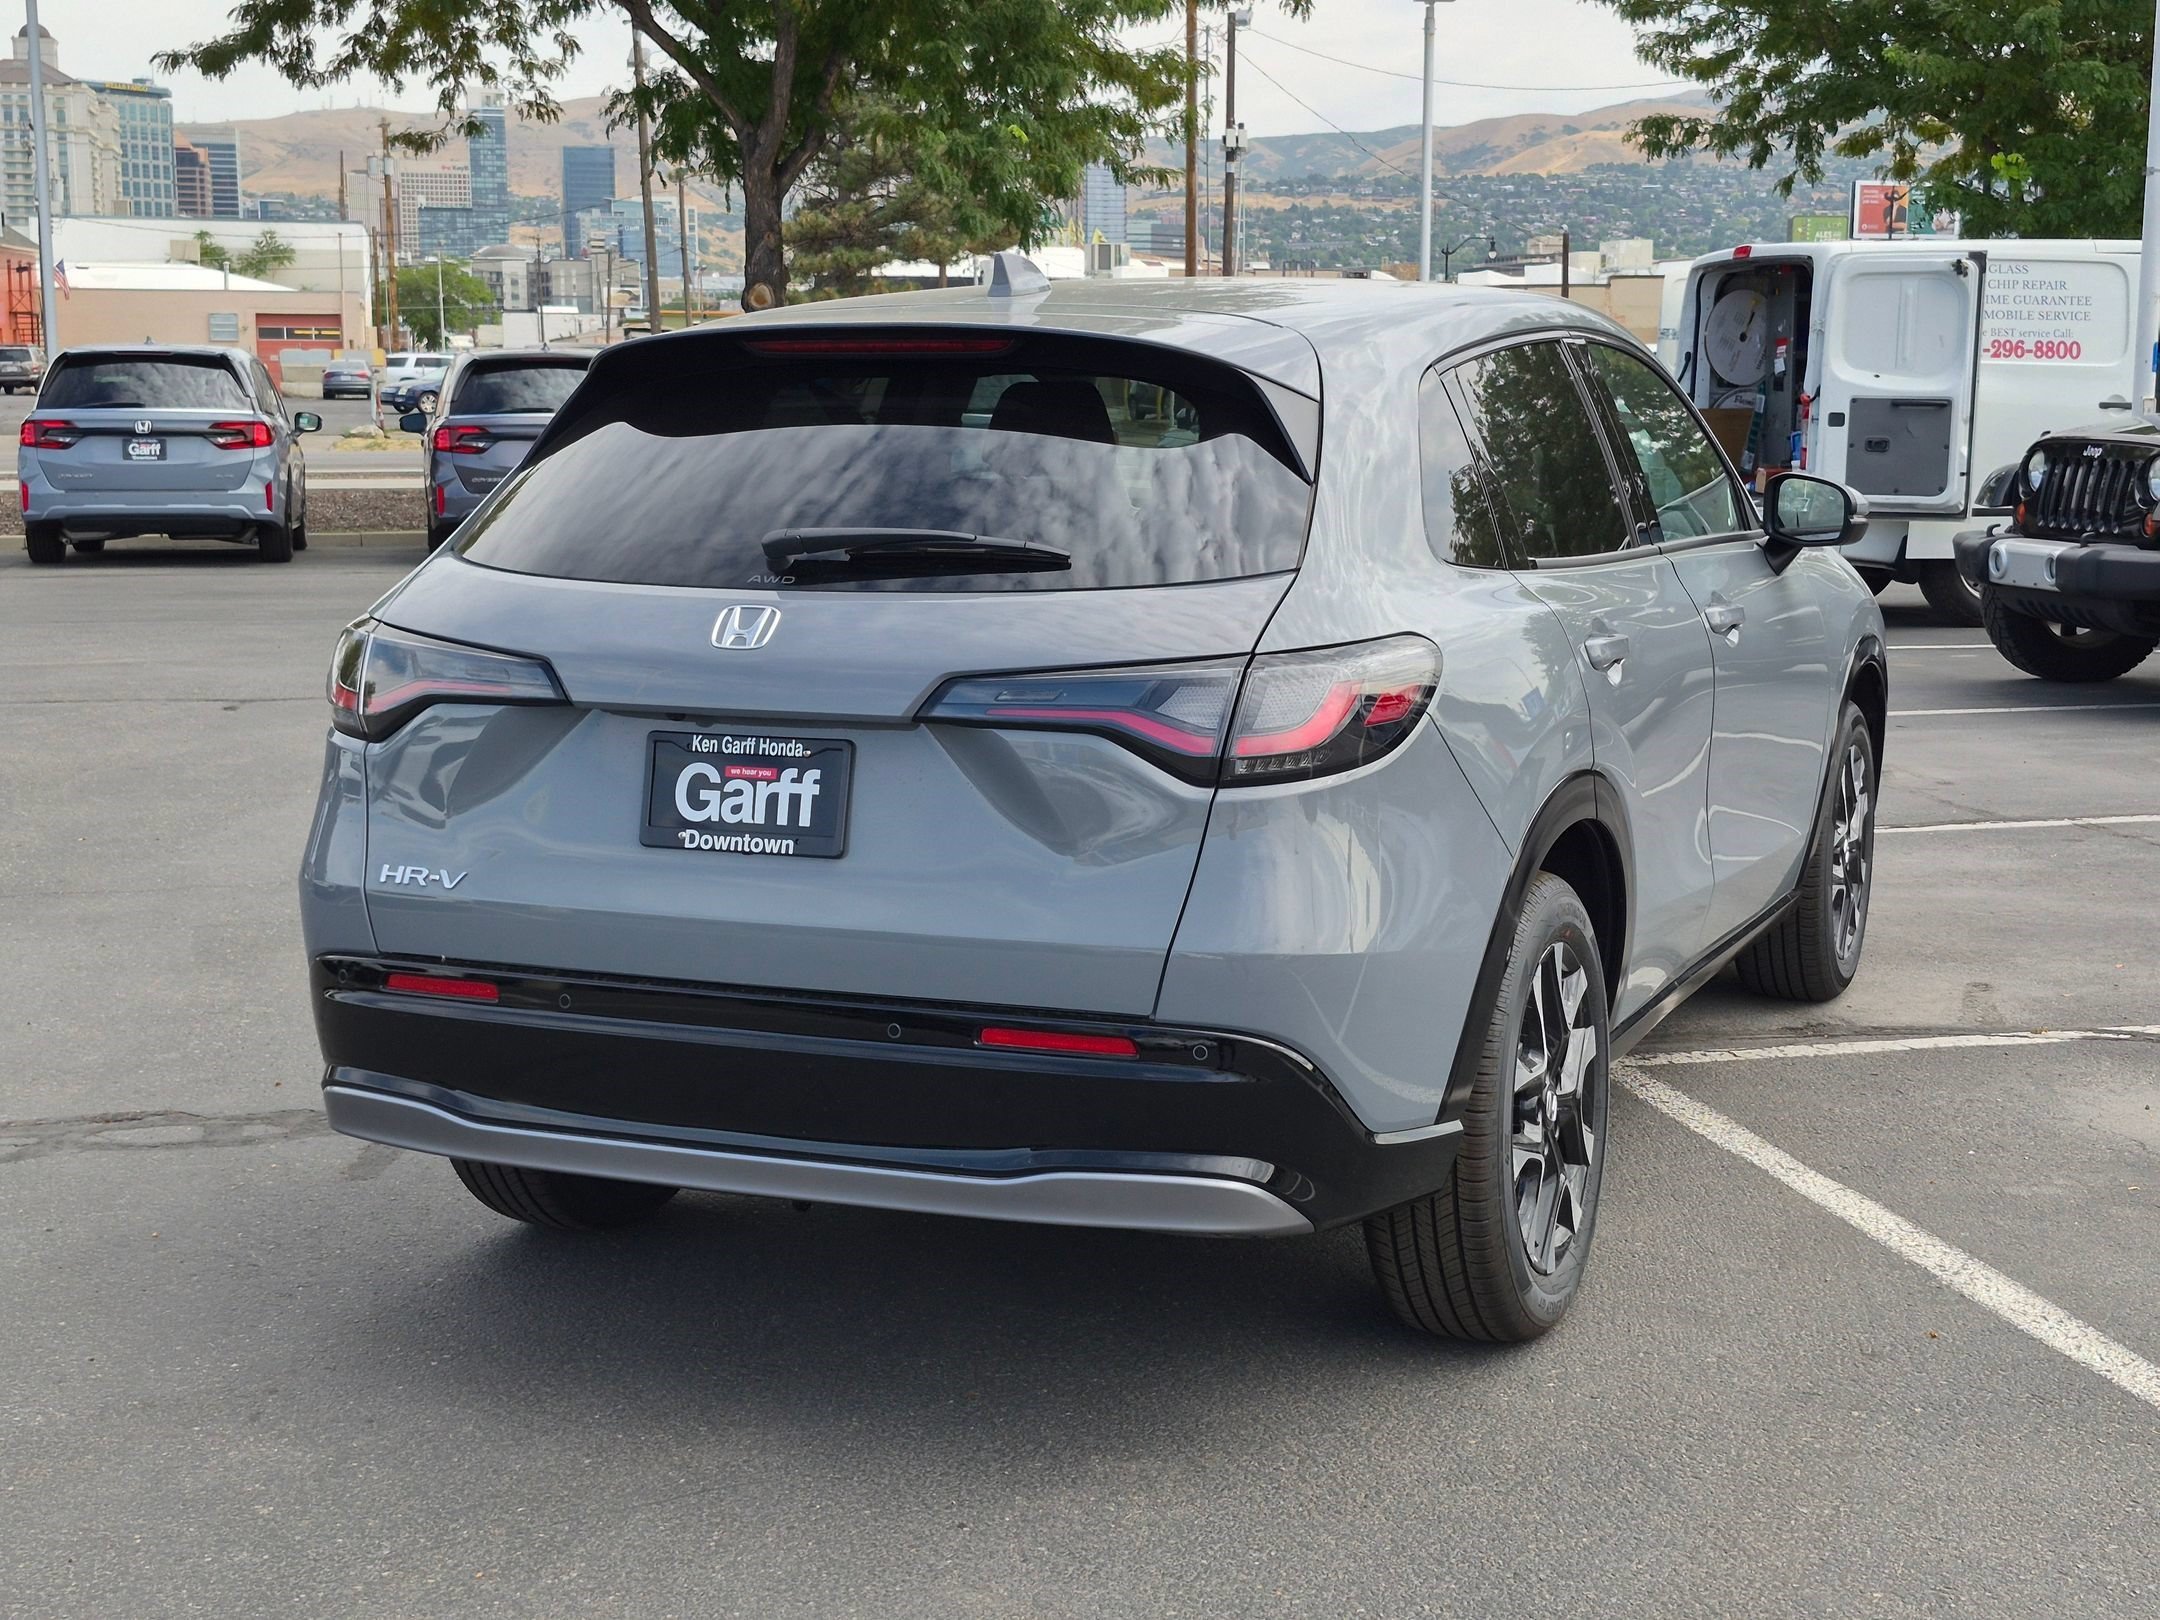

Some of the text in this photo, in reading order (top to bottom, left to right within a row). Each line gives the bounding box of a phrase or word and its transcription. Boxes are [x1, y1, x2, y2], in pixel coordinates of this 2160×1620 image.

[1988, 264, 2029, 274] GLASS
[1987, 279, 2067, 290] CHIP REPAIR
[1985, 294, 2092, 306] IME GUARANTEE
[1984, 310, 2091, 321] MOBILE SERVICE
[1990, 328, 2017, 337] BEST
[2019, 329, 2050, 338] service
[1983, 339, 2081, 360] -296-8800
[128, 443, 161, 456] Garff
[2082, 445, 2103, 459] Jeep
[746, 575, 796, 585] AWD
[691, 734, 803, 757] Ken Garff Honda
[742, 768, 757, 776] hear
[758, 769, 772, 777] you
[674, 761, 821, 828] Garff
[684, 829, 795, 855] Downtown
[379, 864, 469, 889] HR-V
